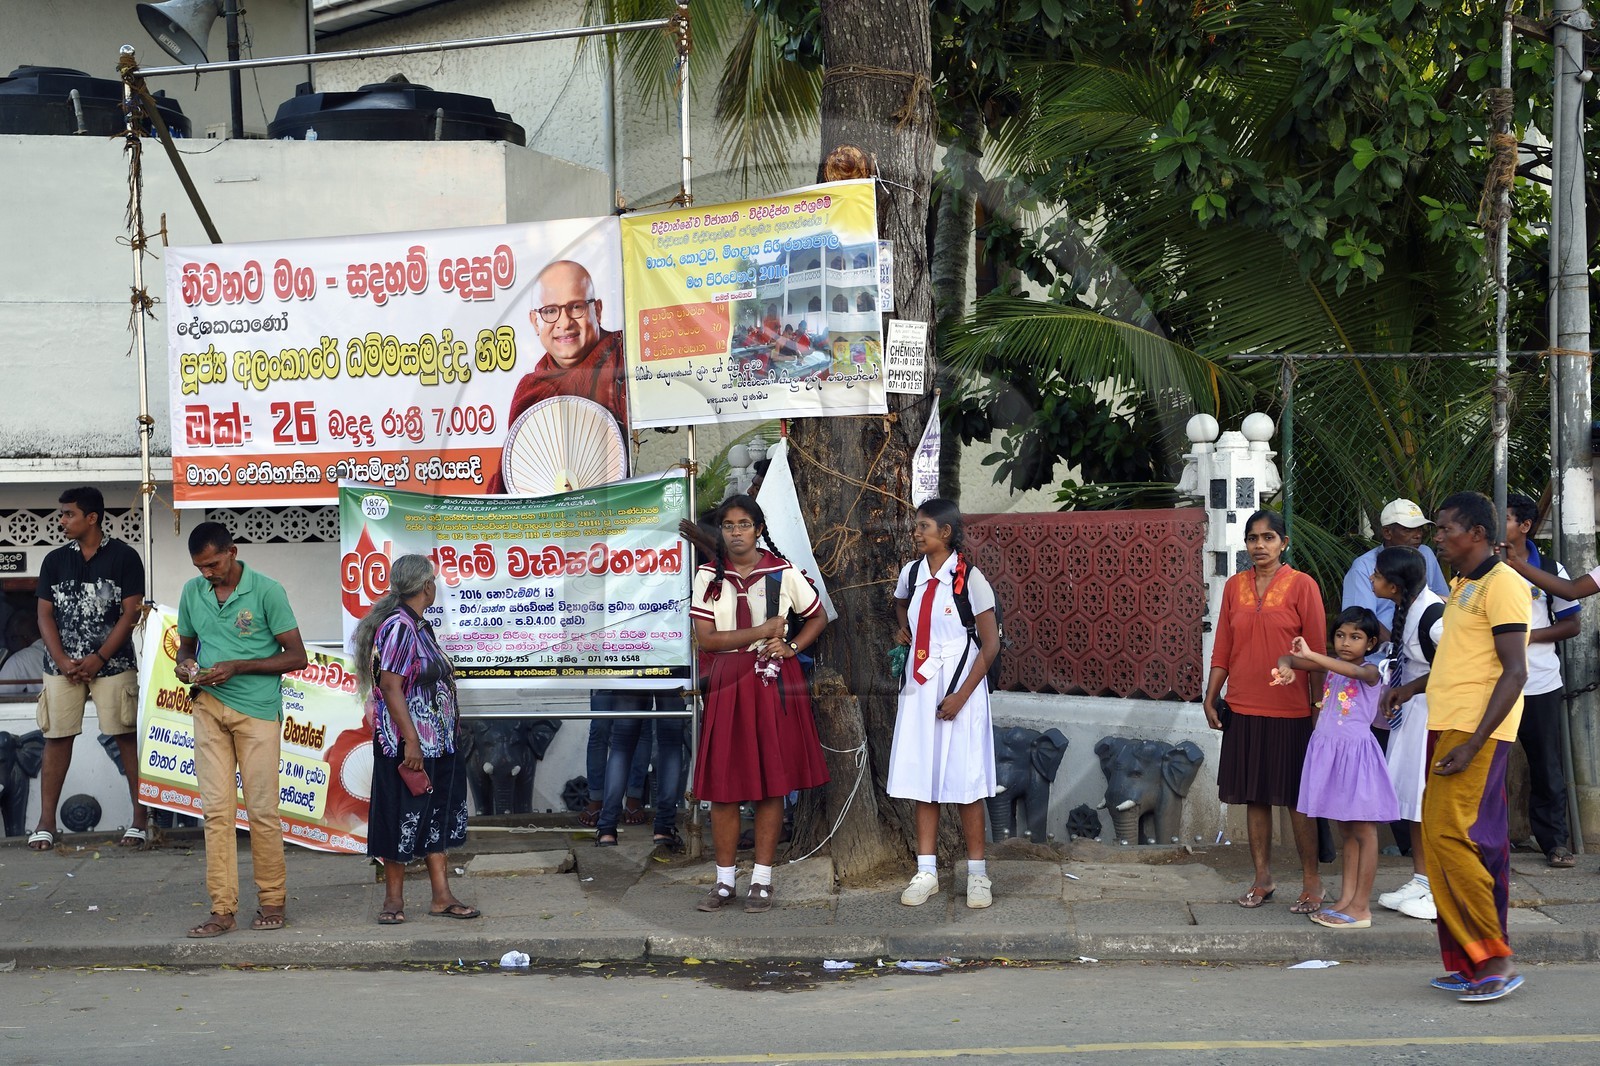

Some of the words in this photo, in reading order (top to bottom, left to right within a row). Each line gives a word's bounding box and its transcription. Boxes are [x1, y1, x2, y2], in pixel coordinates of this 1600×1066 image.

[182, 259, 264, 305] නිවනට
[274, 258, 315, 300] මග
[347, 245, 429, 305] සදහම්
[439, 244, 514, 300] දෙසුම
[759, 264, 789, 281] 2016
[233, 336, 340, 391] අලංකාරේ
[475, 325, 516, 373] හිමි
[890, 346, 924, 357] CHEMISTRY
[888, 370, 923, 381] PHYSICS
[271, 400, 317, 443] 26
[432, 404, 496, 435] 7.00ට
[186, 462, 231, 486] මාතර
[415, 455, 483, 485] අභියසදී
[364, 498, 385, 507] 1897
[366, 507, 386, 516] 2017
[507, 541, 683, 578] වැඩසටහනක්
[459, 589, 482, 600] 2016
[545, 587, 554, 598] 13
[149, 750, 177, 771] මාතර
[285, 761, 304, 779] 8.00
